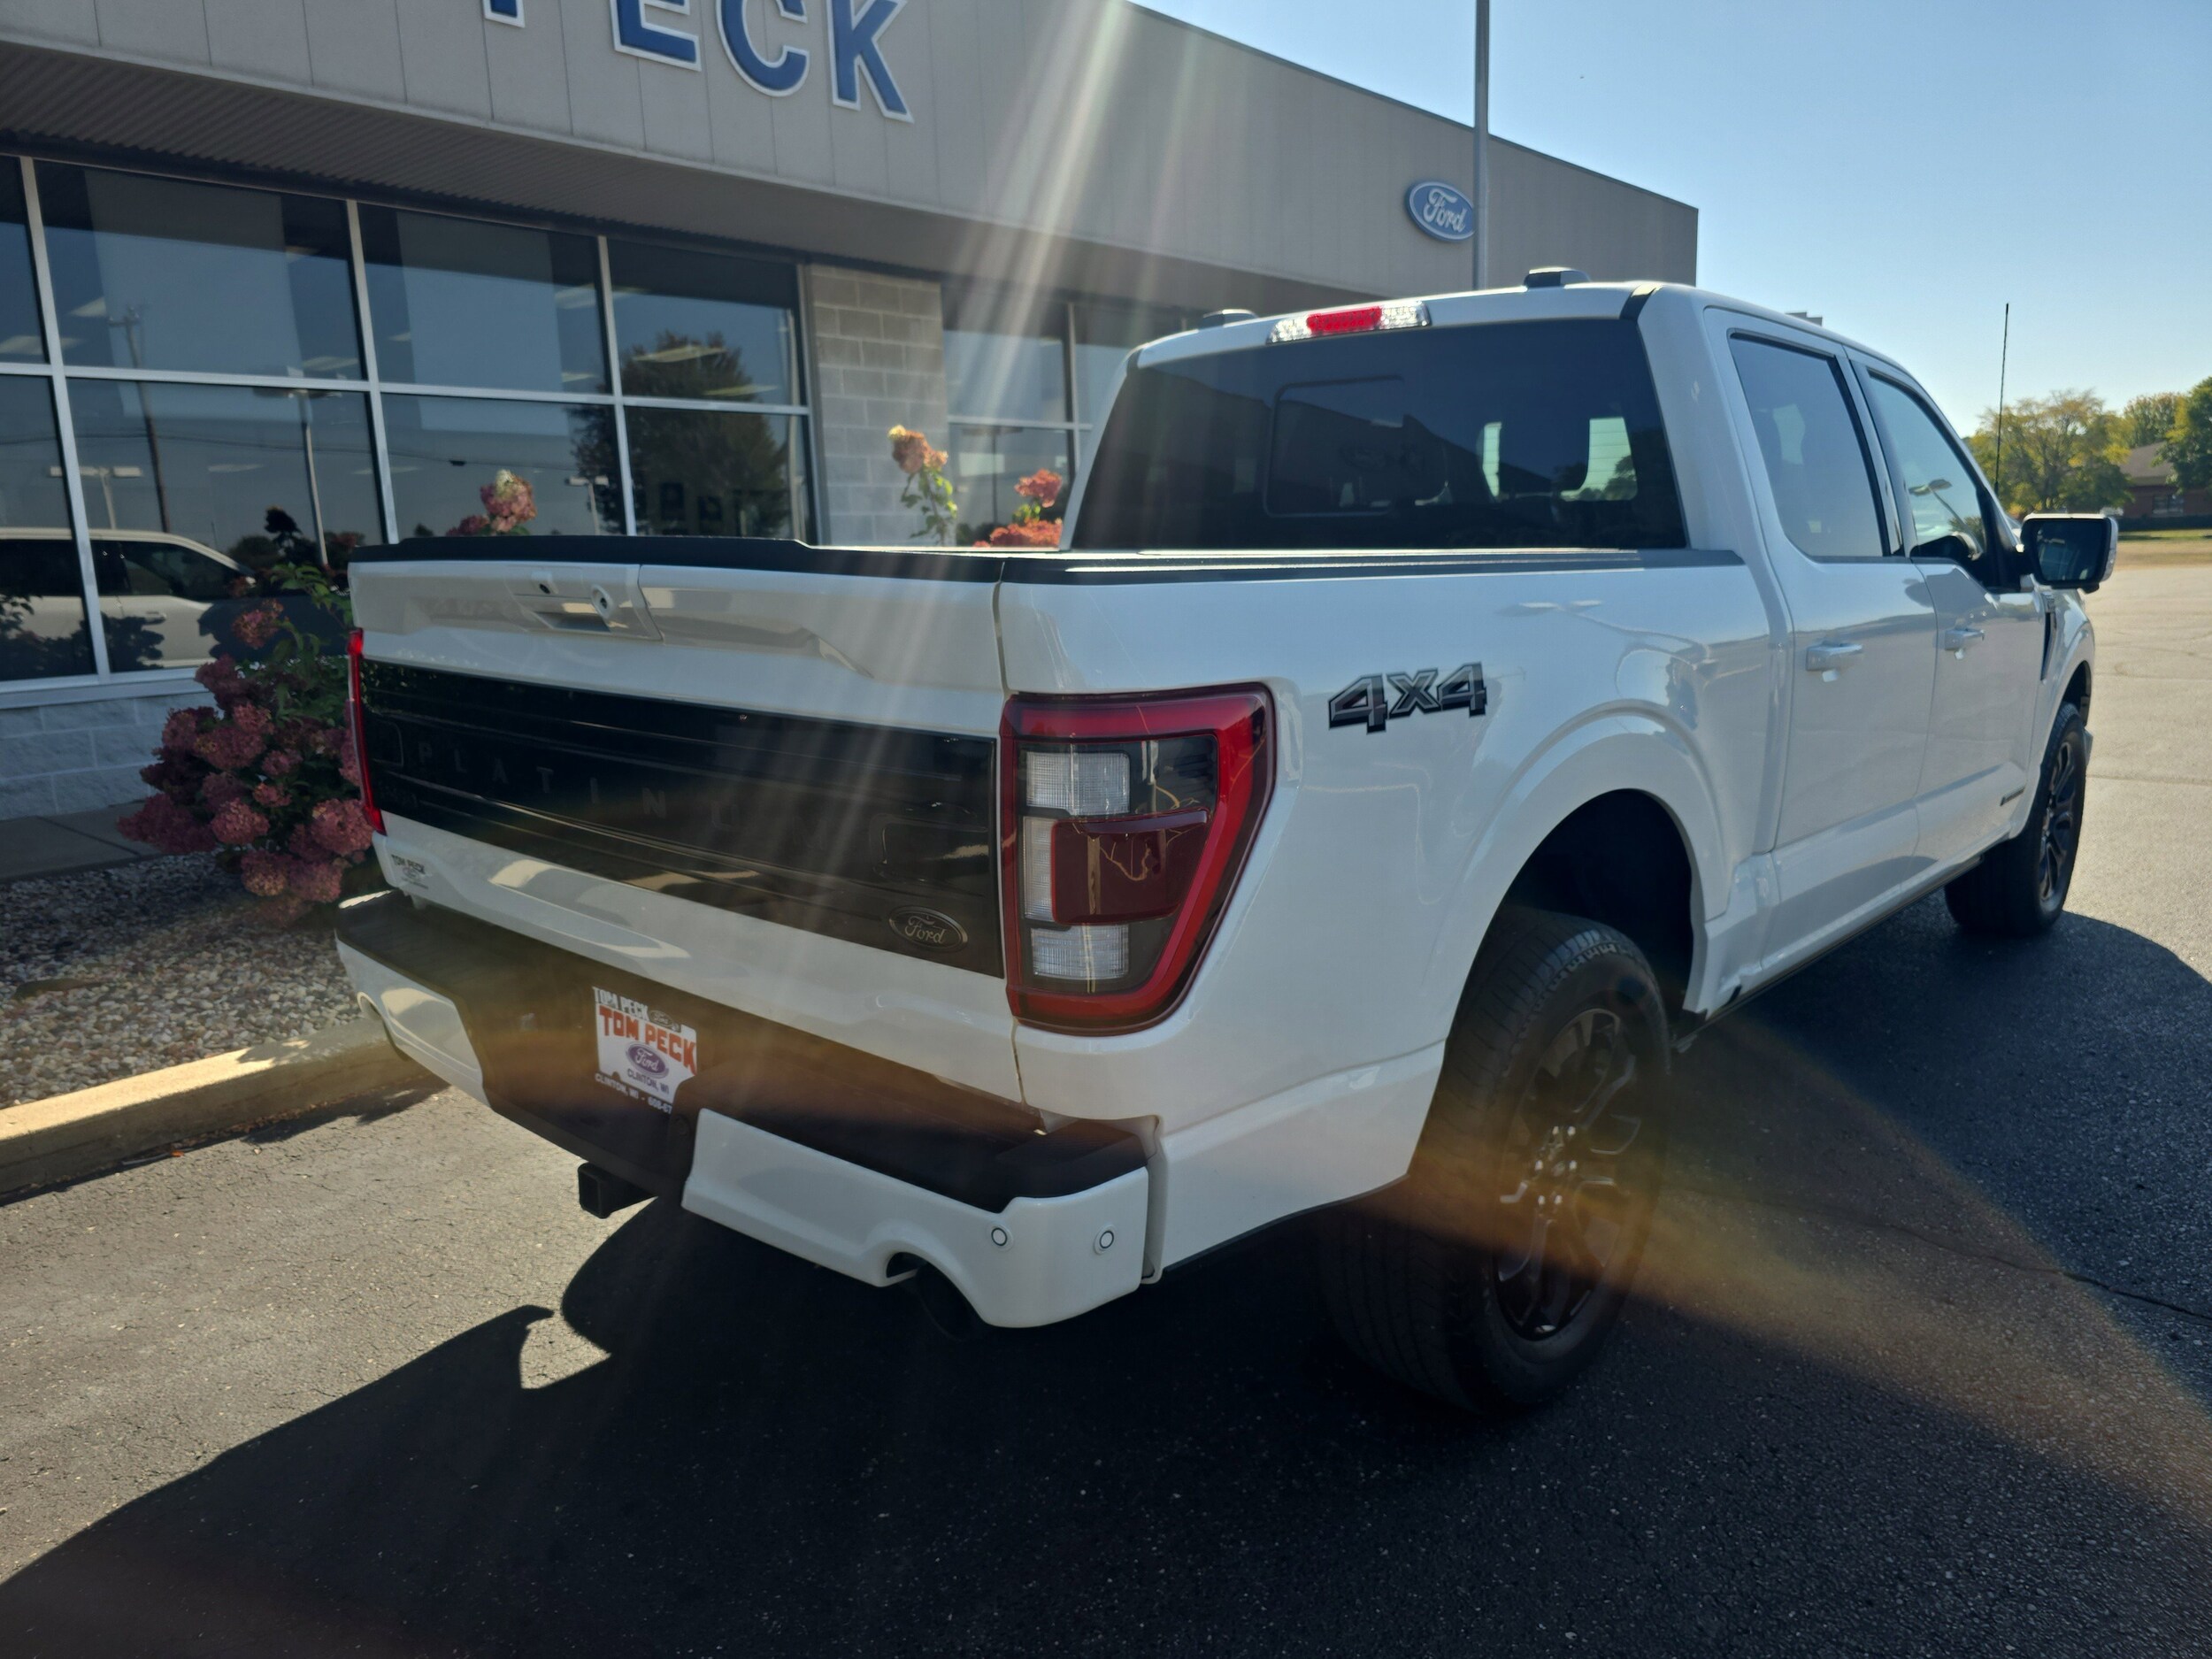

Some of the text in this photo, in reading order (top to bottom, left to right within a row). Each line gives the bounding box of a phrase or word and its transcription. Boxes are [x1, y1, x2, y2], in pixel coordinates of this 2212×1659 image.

[484, 0, 915, 123] ECK
[1423, 188, 1468, 233] Ford
[418, 740, 828, 849] PLATINUM
[904, 915, 948, 944] Ford
[620, 996, 650, 1022] PECK
[599, 1005, 697, 1076] TOM PECK
[634, 1048, 660, 1072] Ford
